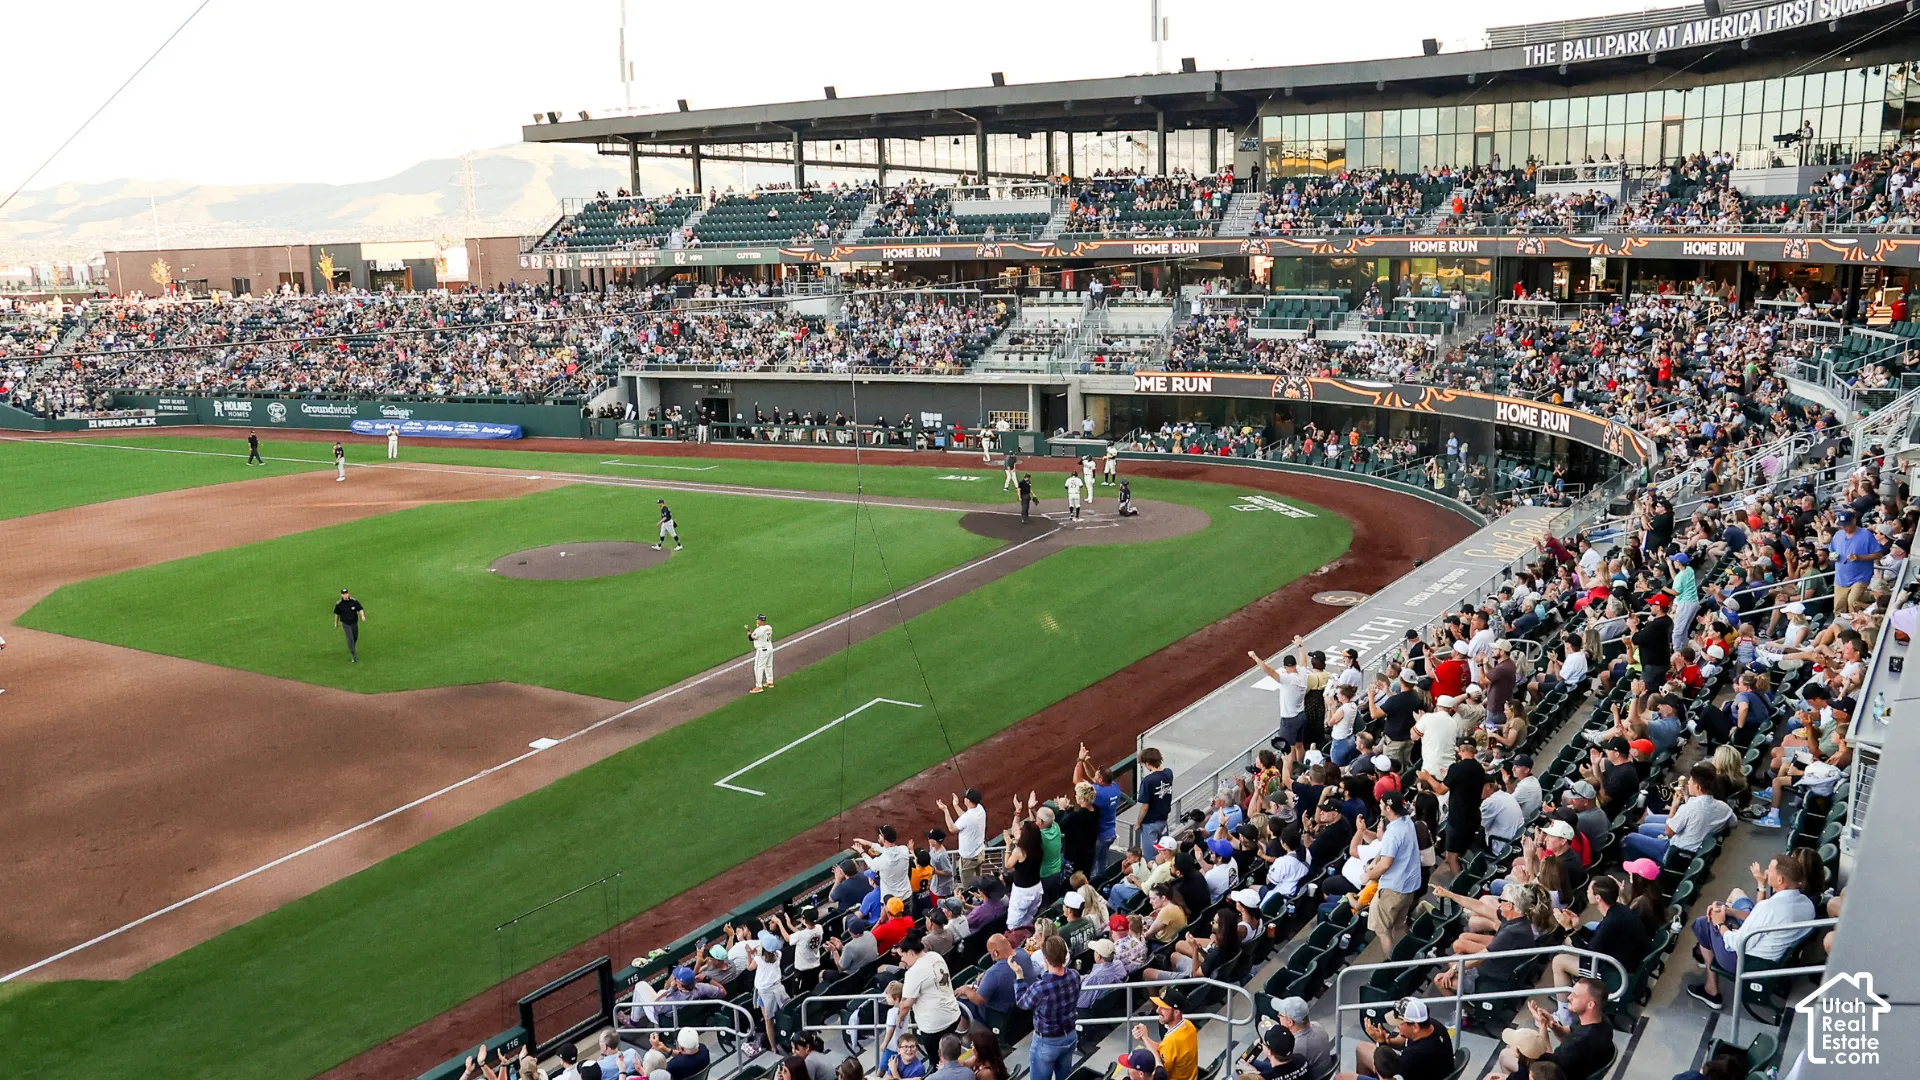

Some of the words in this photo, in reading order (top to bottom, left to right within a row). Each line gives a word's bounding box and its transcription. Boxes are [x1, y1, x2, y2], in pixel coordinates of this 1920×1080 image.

[1523, 43, 1556, 66] THE
[1562, 30, 1652, 62] BALLPARK
[1655, 26, 1679, 50] AT
[1682, 15, 1763, 46] AMERICA
[1766, 0, 1815, 30] FIRST
[882, 248, 914, 259] HOME
[916, 247, 941, 258] RUN
[1133, 243, 1169, 255] HOME
[1172, 243, 1200, 254] RUN
[1409, 241, 1446, 253] HOME
[1449, 241, 1478, 253] RUN
[1683, 242, 1717, 255] HOME
[1719, 242, 1745, 255] RUN
[674, 251, 686, 265] 82
[736, 252, 762, 260] CUTTER
[1172, 376, 1212, 392] RUN
[223, 401, 252, 411] HOLMES
[301, 403, 357, 415] Groundworks
[98, 417, 157, 428] MEGAPLEX
[1496, 402, 1538, 427] HOME
[1541, 410, 1570, 433] RUN
[627, 973, 639, 985] 115
[506, 1038, 519, 1050] 116
